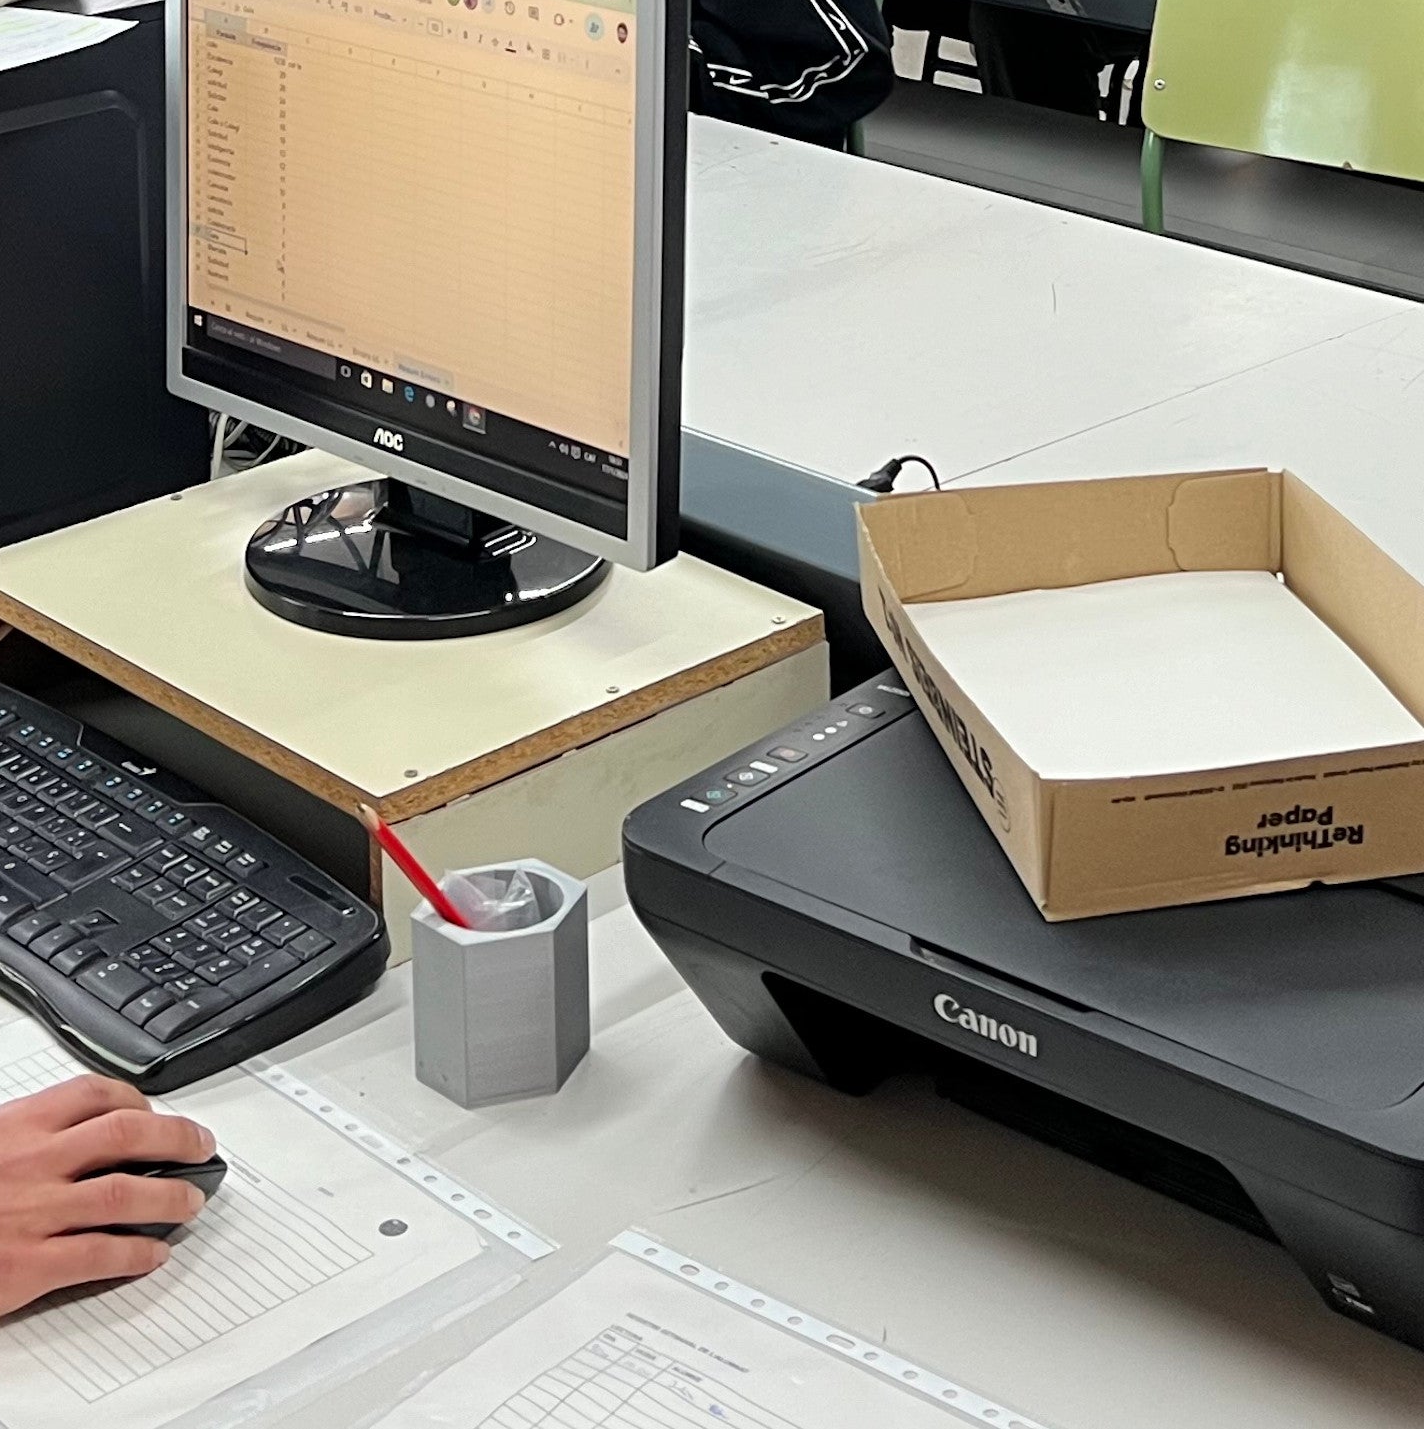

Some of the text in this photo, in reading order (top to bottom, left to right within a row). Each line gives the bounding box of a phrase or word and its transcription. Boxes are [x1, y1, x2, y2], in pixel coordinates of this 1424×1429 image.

[373, 427, 404, 452] AOC
[1256, 805, 1334, 830] Paper
[1224, 824, 1364, 858] ReThinking
[933, 993, 1037, 1058] Canon
